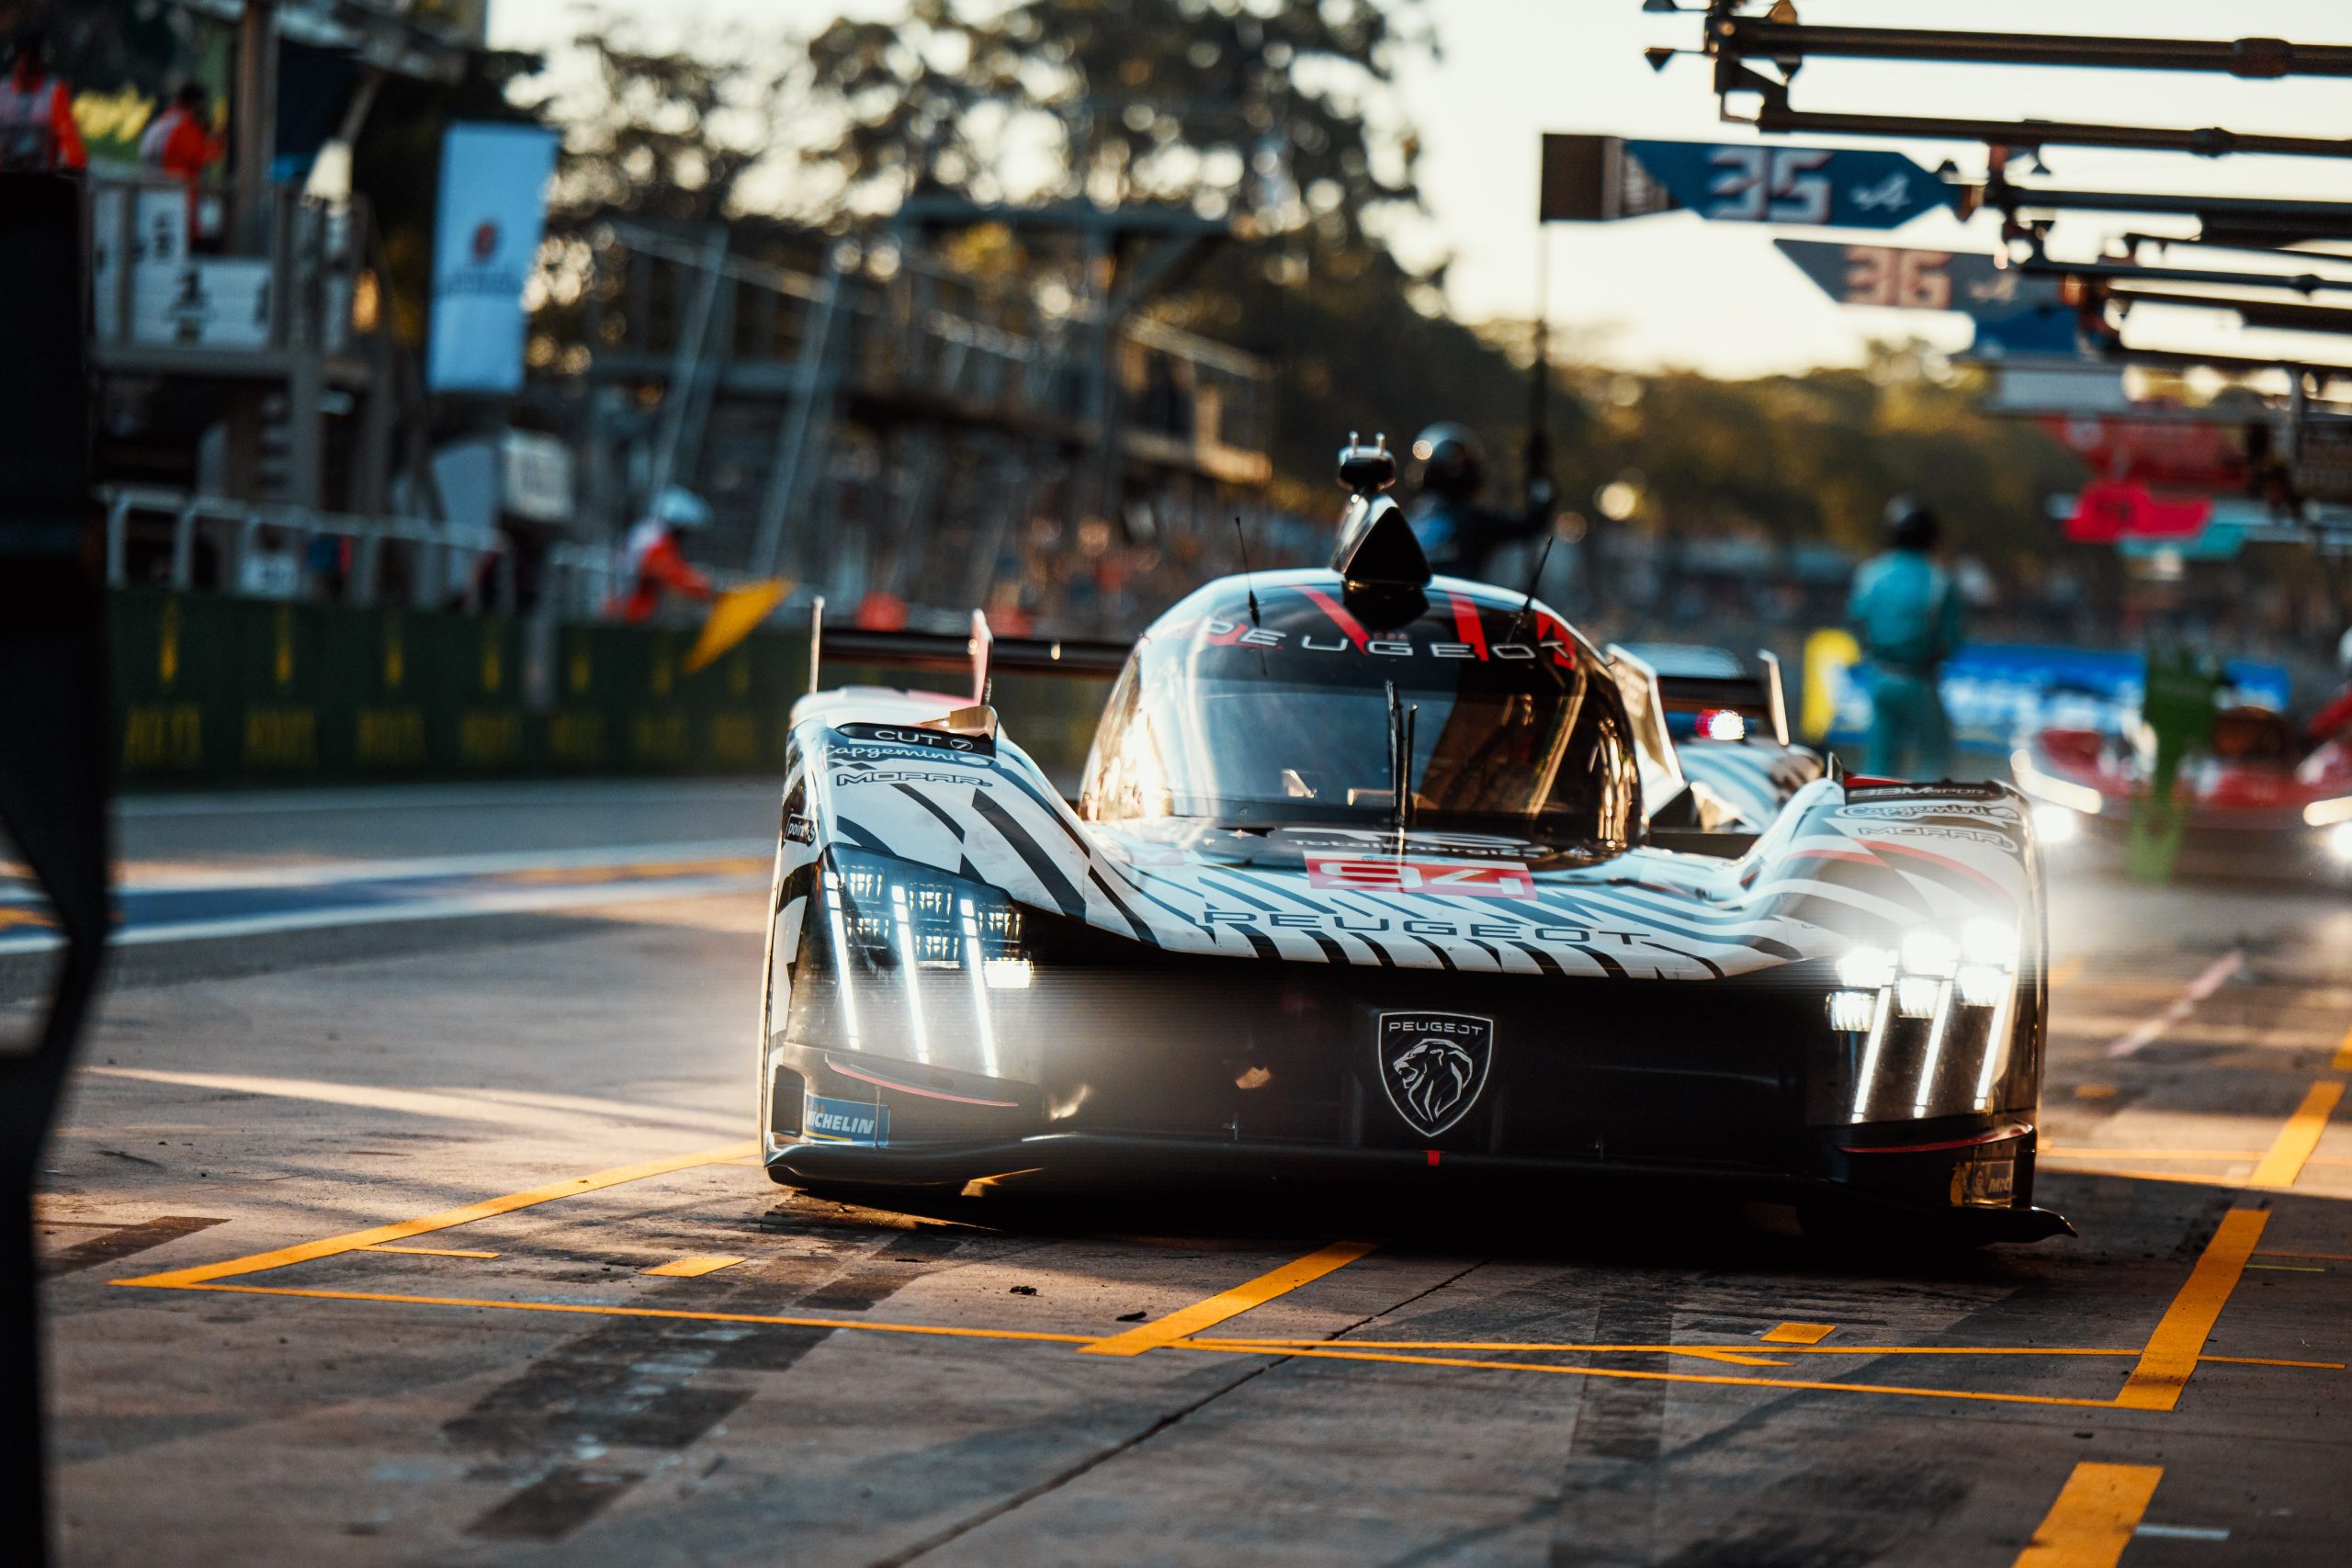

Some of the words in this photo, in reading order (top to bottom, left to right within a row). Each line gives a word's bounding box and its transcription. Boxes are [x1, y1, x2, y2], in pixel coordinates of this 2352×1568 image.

[1707, 144, 1834, 225] 35
[1843, 245, 1952, 310] 36
[1205, 619, 1569, 660] PEUGEOT
[824, 745, 956, 761] Capgemini
[875, 730, 942, 745] CUT
[1846, 805, 1986, 817] Capgemini
[1319, 863, 1525, 896] 94
[1204, 910, 1651, 945] PEUGEOT
[1388, 1021, 1484, 1036] PEUGEOT
